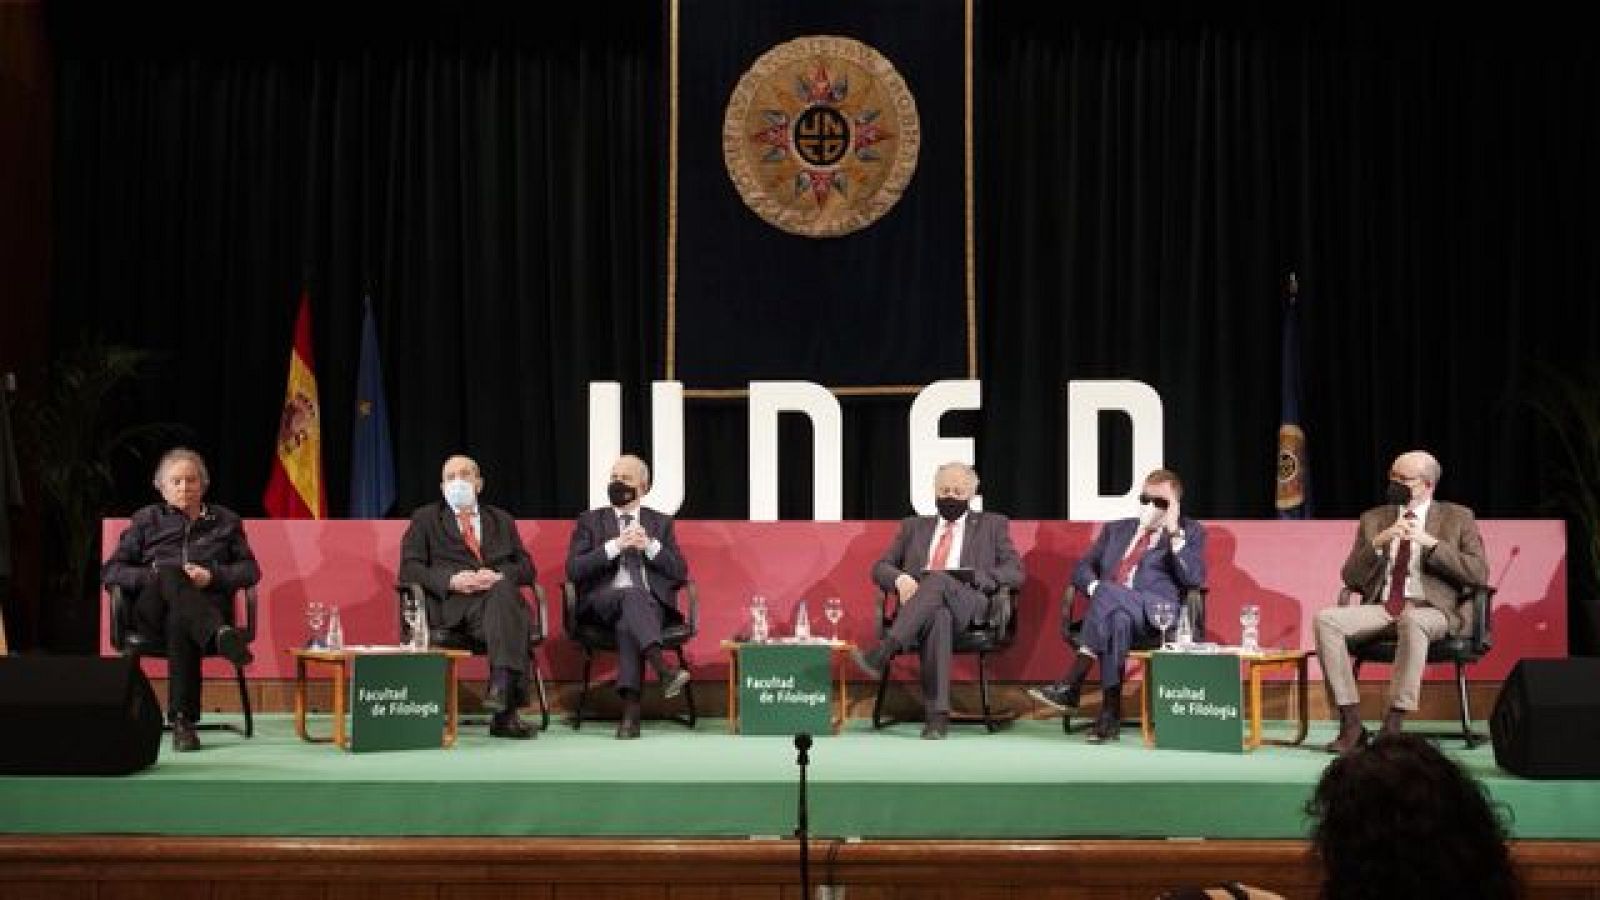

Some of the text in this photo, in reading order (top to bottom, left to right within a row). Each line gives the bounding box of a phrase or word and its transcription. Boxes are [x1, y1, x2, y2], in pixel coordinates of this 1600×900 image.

[589, 379, 1165, 520] UNED
[746, 675, 795, 689] Facultad
[359, 687, 407, 701] Facultad
[760, 690, 773, 704] de
[1159, 685, 1206, 701] Facultad
[371, 701, 386, 716] de
[1171, 701, 1186, 715] de
